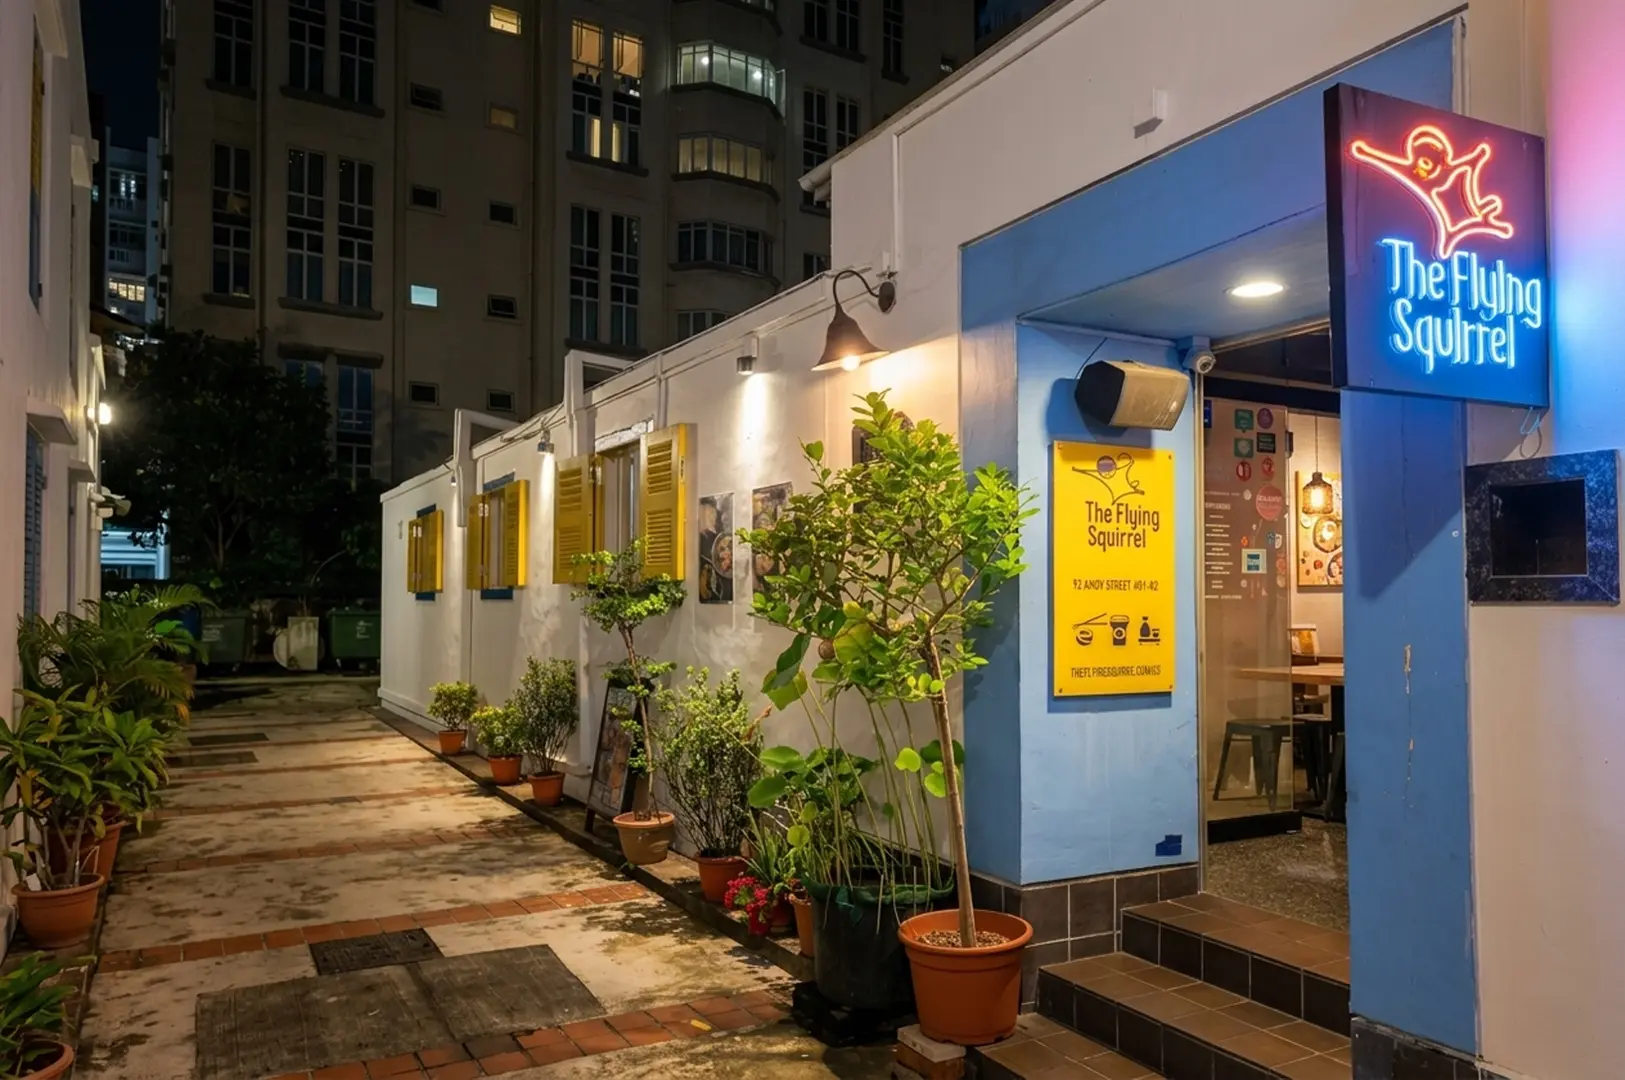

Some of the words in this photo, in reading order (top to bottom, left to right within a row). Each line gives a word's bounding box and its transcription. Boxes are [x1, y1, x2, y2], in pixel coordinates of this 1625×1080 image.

[1381, 238, 1445, 300] The
[1085, 500, 1113, 524] The
[1116, 502, 1160, 533] Flying
[1088, 525, 1146, 553] Squirrel
[1072, 578, 1082, 590] 92
[1106, 579, 1132, 592] STREET
